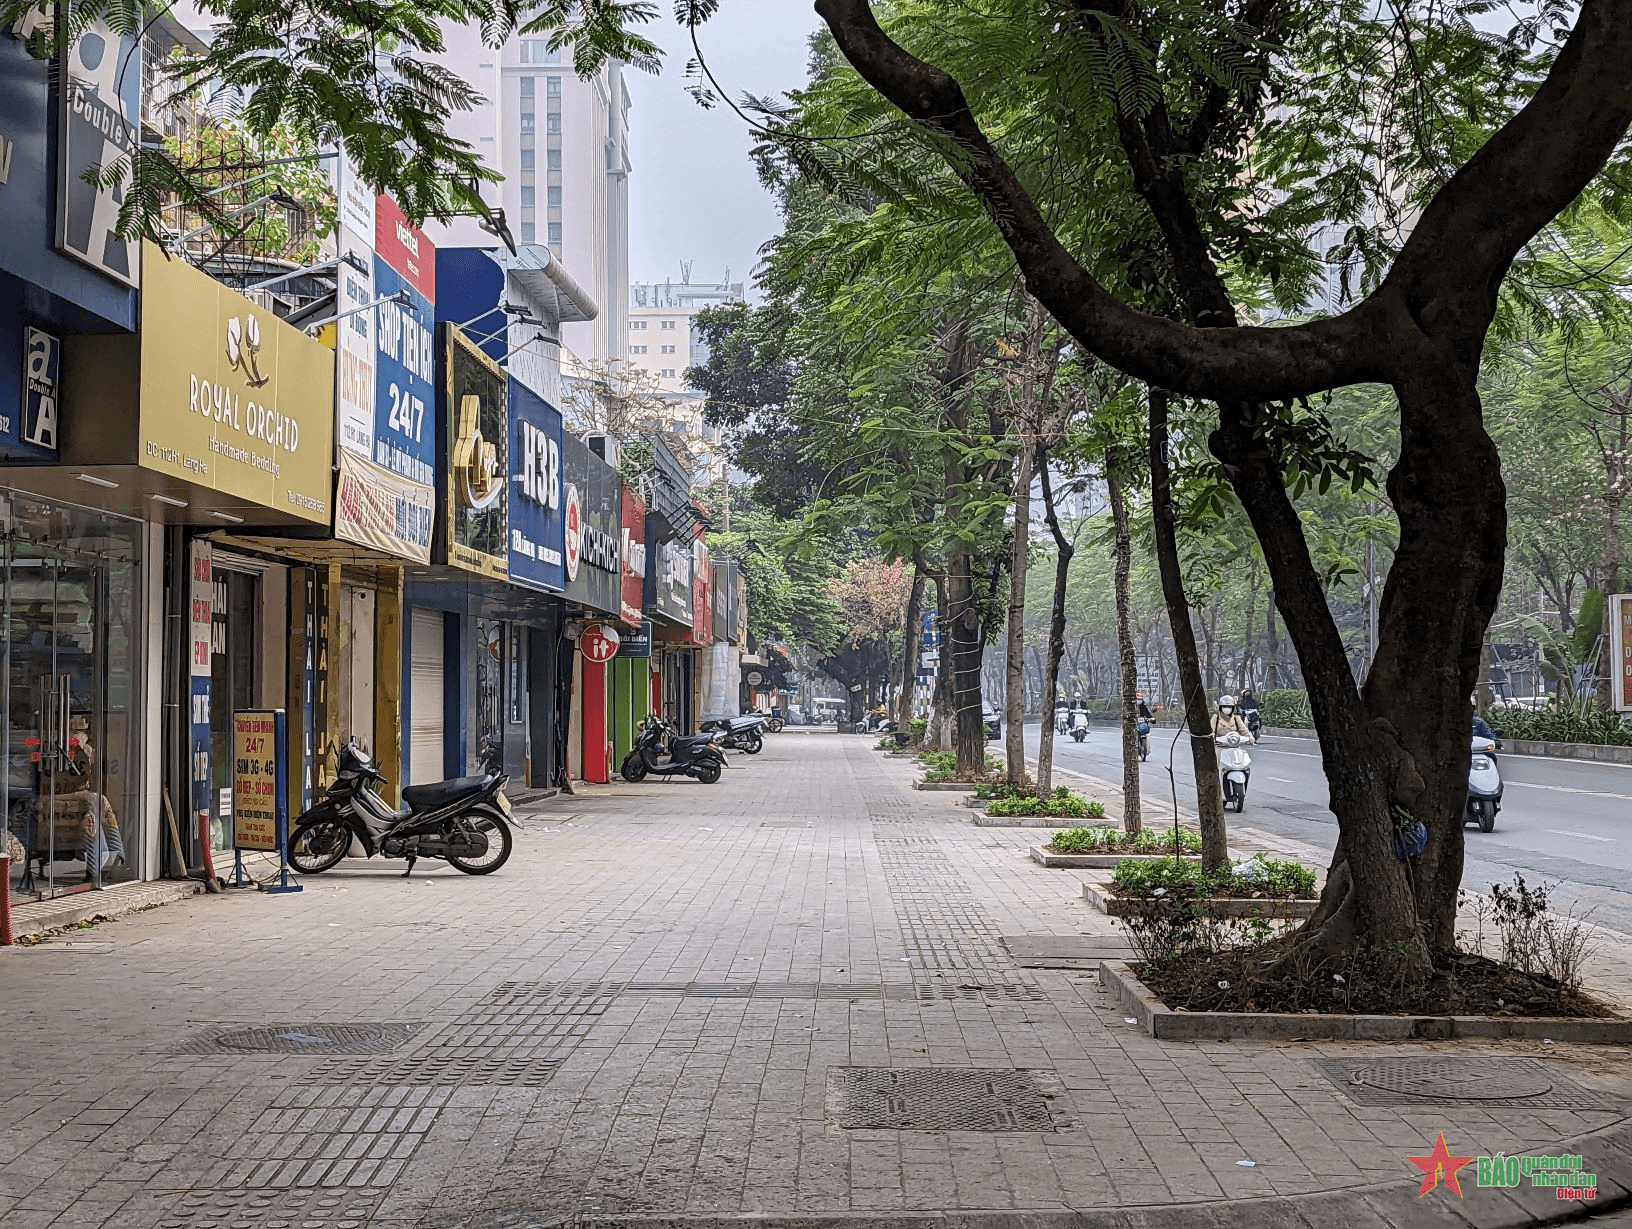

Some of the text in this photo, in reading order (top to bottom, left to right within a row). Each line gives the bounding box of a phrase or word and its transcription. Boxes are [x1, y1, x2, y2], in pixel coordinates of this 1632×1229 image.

[73, 85, 122, 144] Double
[379, 292, 401, 361] SHOP
[29, 379, 50, 397] Double
[190, 373, 299, 453] ROYAL ORCHID
[208, 434, 281, 480] Handmade Bedding
[236, 758, 249, 775] SIM
[250, 759, 259, 775] 3G
[264, 760, 274, 777] 4G
